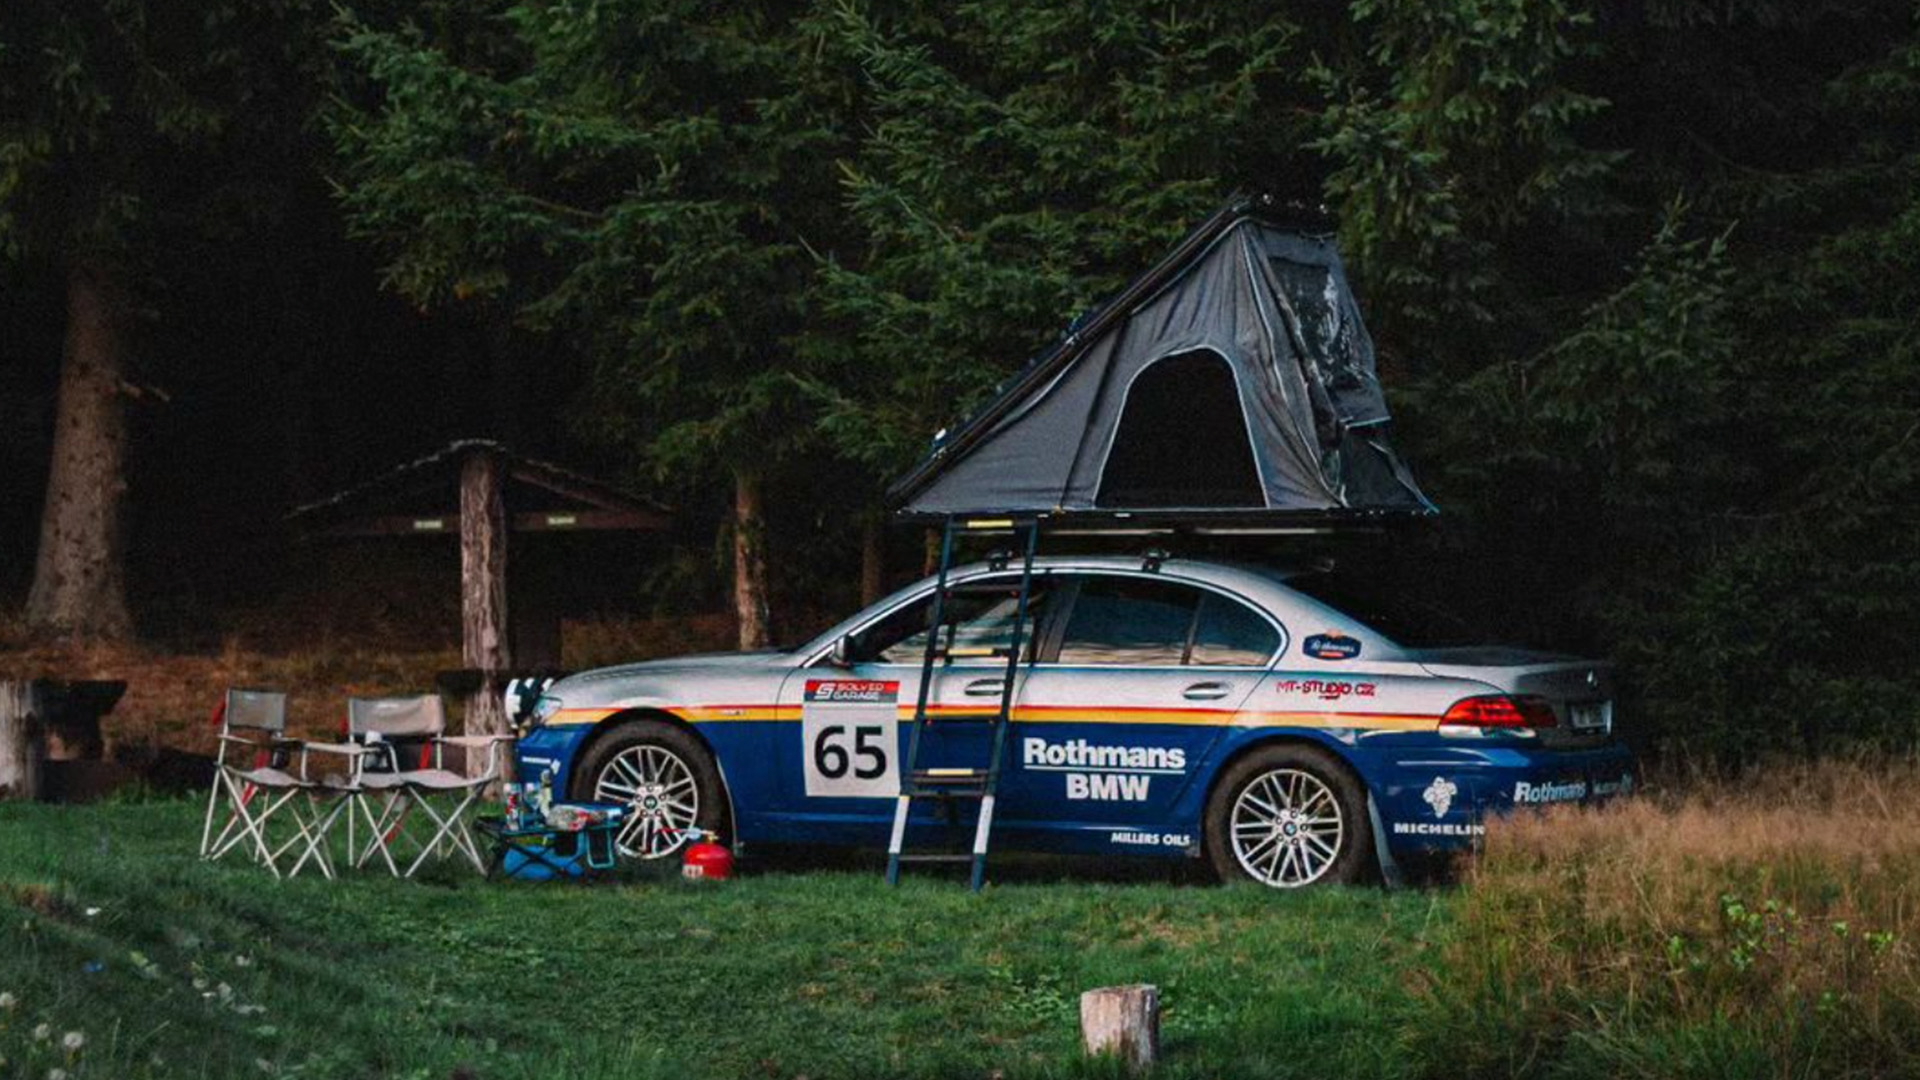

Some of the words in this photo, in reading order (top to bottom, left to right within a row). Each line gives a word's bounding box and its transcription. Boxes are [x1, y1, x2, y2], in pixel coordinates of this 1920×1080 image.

[837, 682, 885, 692] SOLVED
[833, 691, 880, 700] GARAGE
[815, 725, 887, 780] 65
[1024, 737, 1186, 768] Rothmans
[1066, 773, 1150, 802] BMW
[1393, 823, 1486, 835] MICHELIN
[1111, 832, 1159, 845] MILLERS
[1163, 834, 1190, 846] OILS
